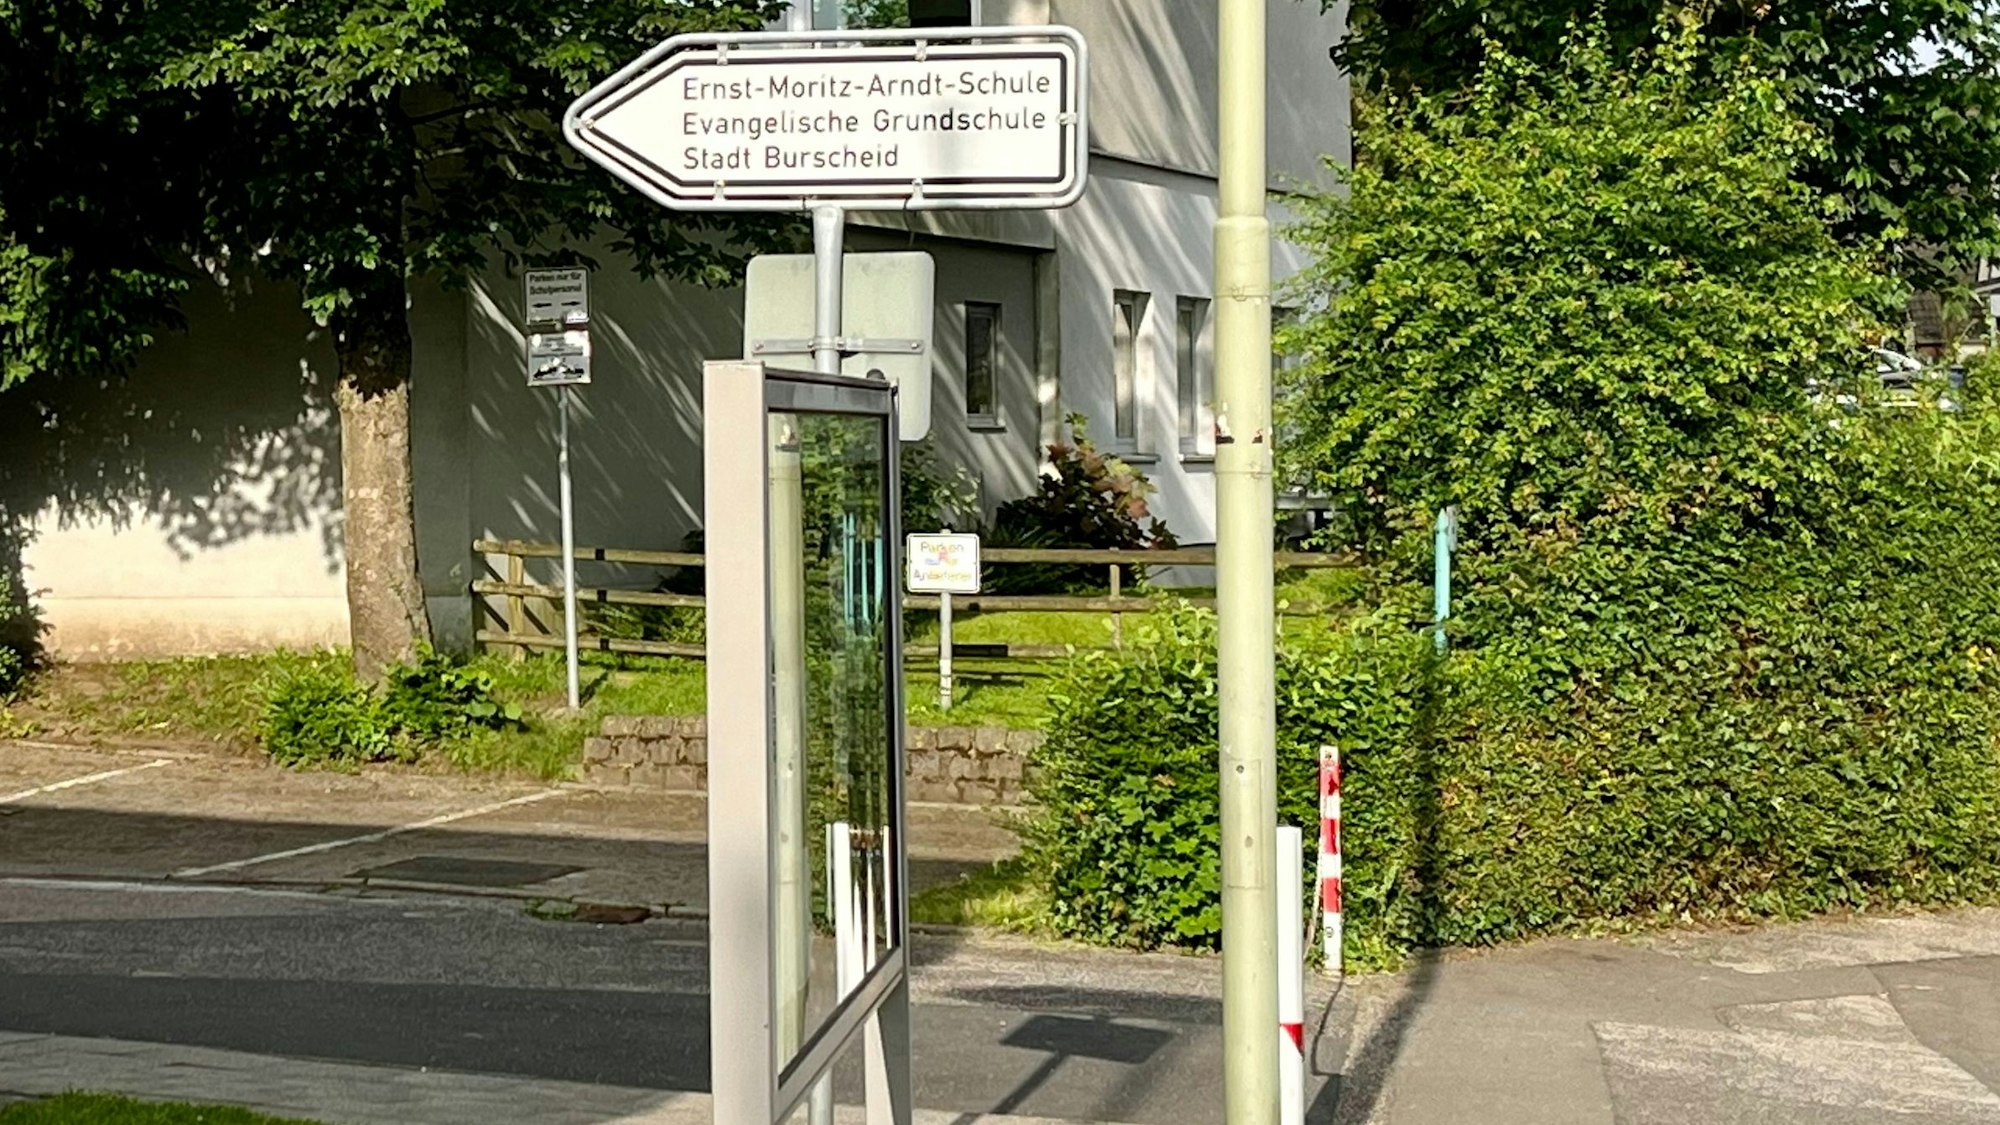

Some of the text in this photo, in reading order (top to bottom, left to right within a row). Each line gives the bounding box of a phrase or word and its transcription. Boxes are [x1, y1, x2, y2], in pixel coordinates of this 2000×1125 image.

[683, 71, 1051, 101] Ernst-Moritz-Arndt-Schule
[683, 107, 1046, 140] Evangelische Grundschule
[683, 144, 899, 170] Stadt Burscheid
[529, 274, 555, 283] Parken
